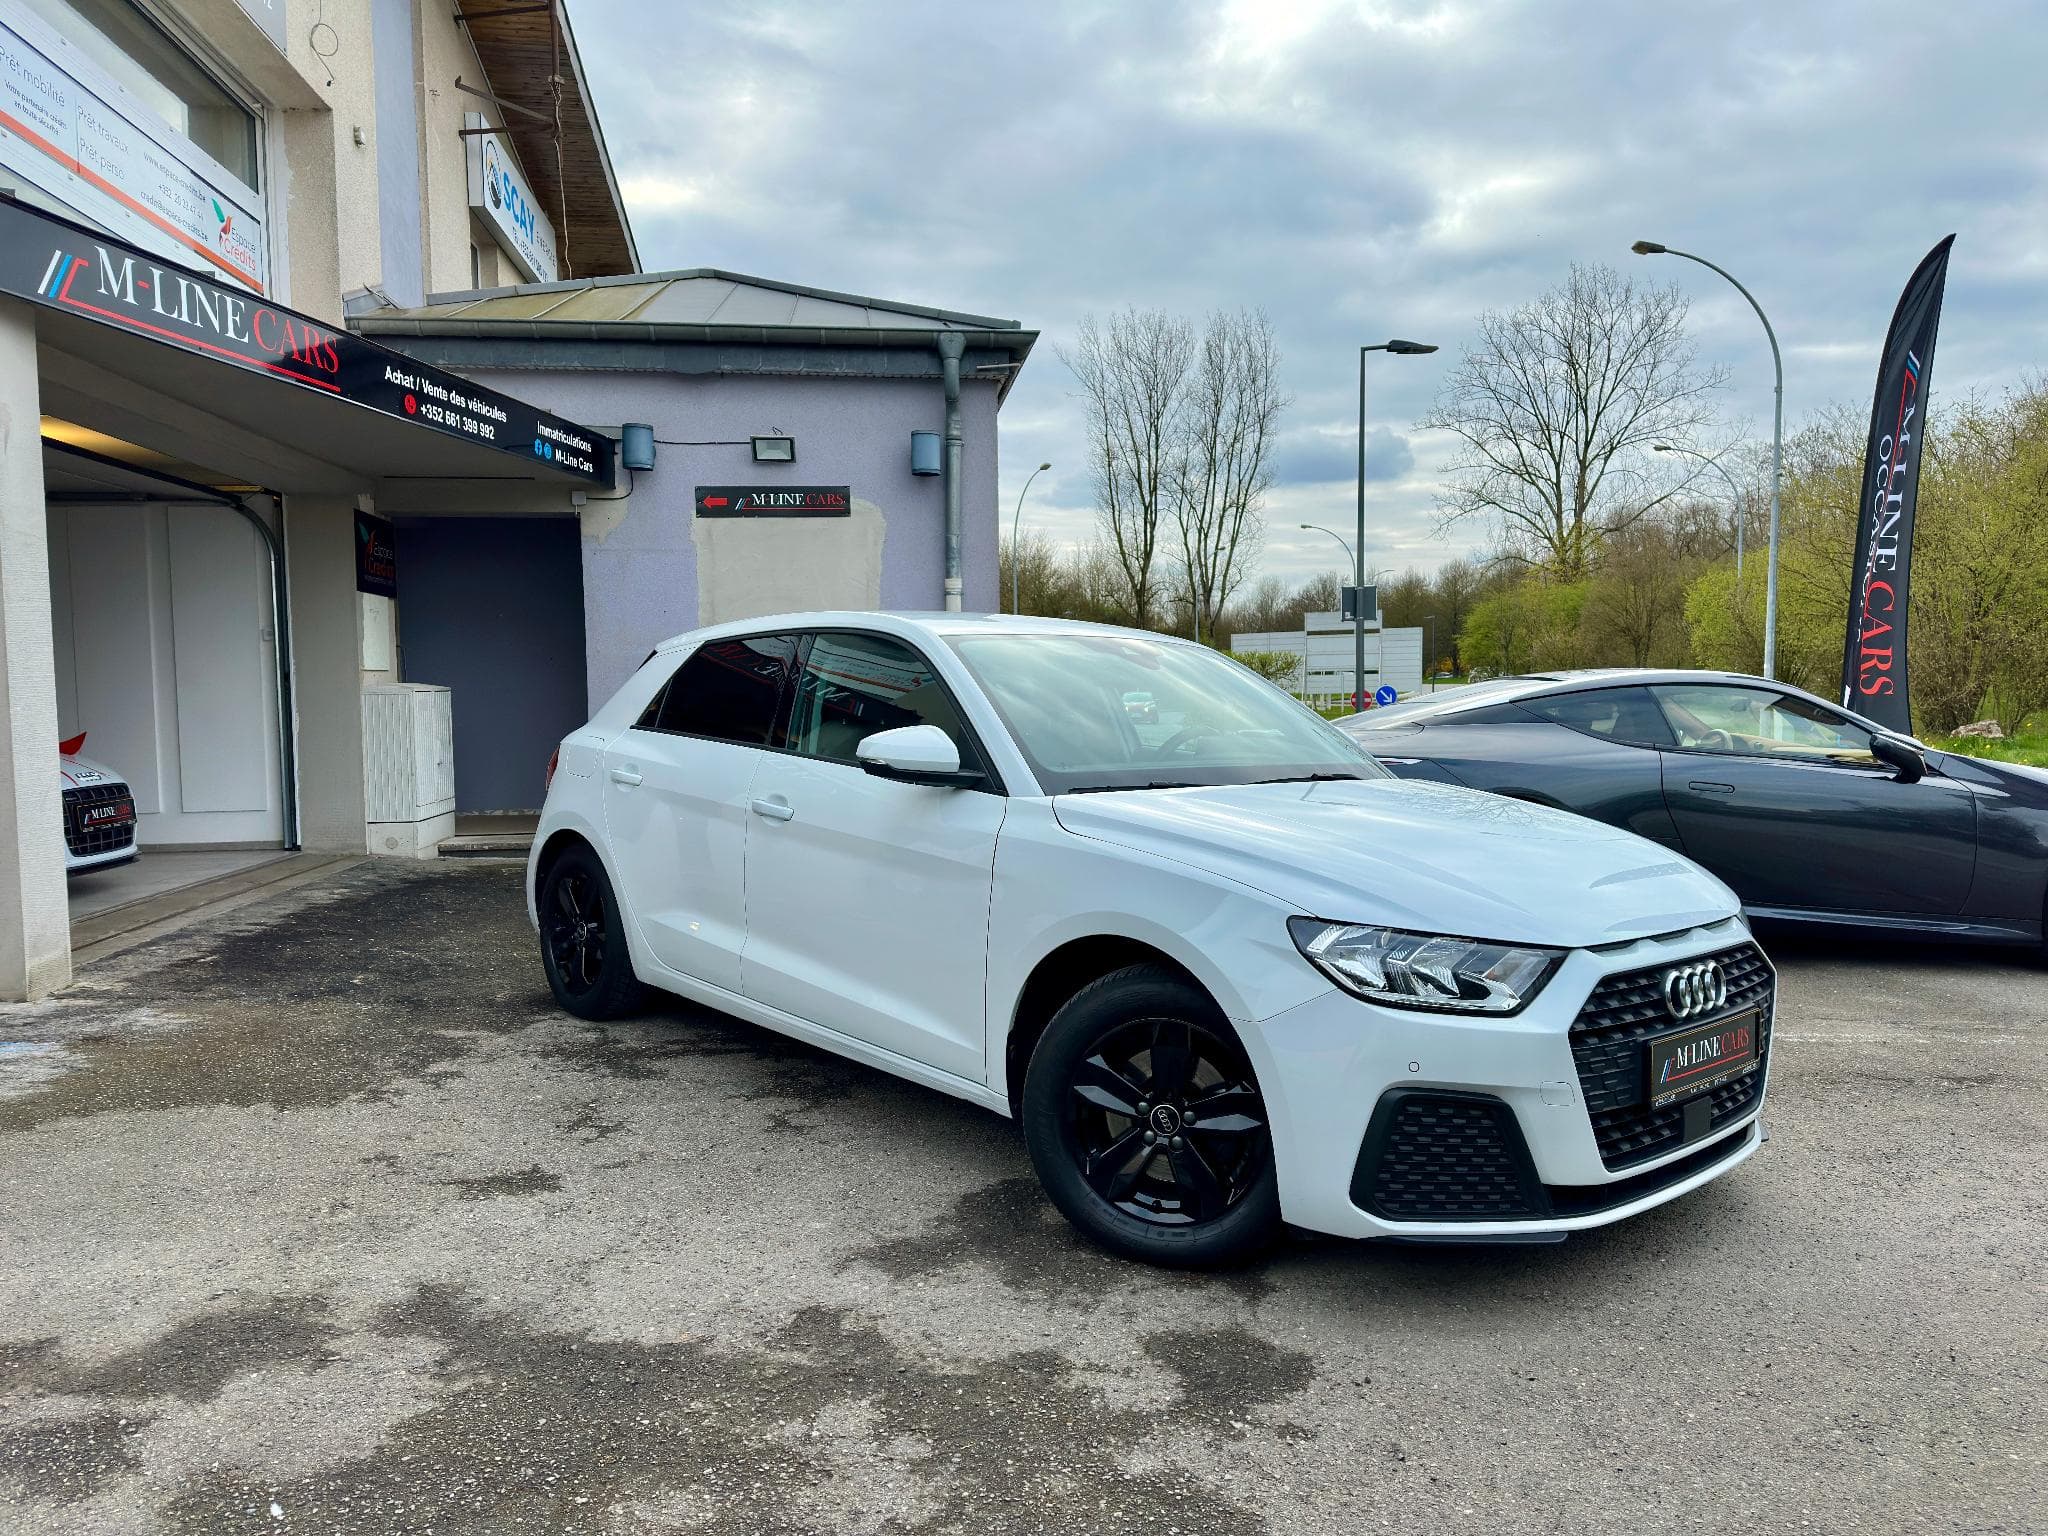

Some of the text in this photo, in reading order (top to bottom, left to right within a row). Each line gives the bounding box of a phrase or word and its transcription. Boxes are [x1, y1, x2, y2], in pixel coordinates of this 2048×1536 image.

[503, 171, 535, 246] SCAY
[94, 245, 339, 374] M-LINE CARS
[384, 365, 415, 390] Achat
[421, 378, 449, 402] Vente
[449, 390, 466, 408] des
[467, 397, 507, 423] véhicules
[420, 403, 495, 440] +352 661 399 992
[537, 420, 592, 453] Immatriculations
[555, 448, 594, 473] M-Line Cars
[805, 492, 844, 506] CARS
[1859, 402, 1916, 696] M-LINE CARS
[1677, 1035, 1721, 1069] M-LINE
[1721, 1026, 1749, 1054] CARS
